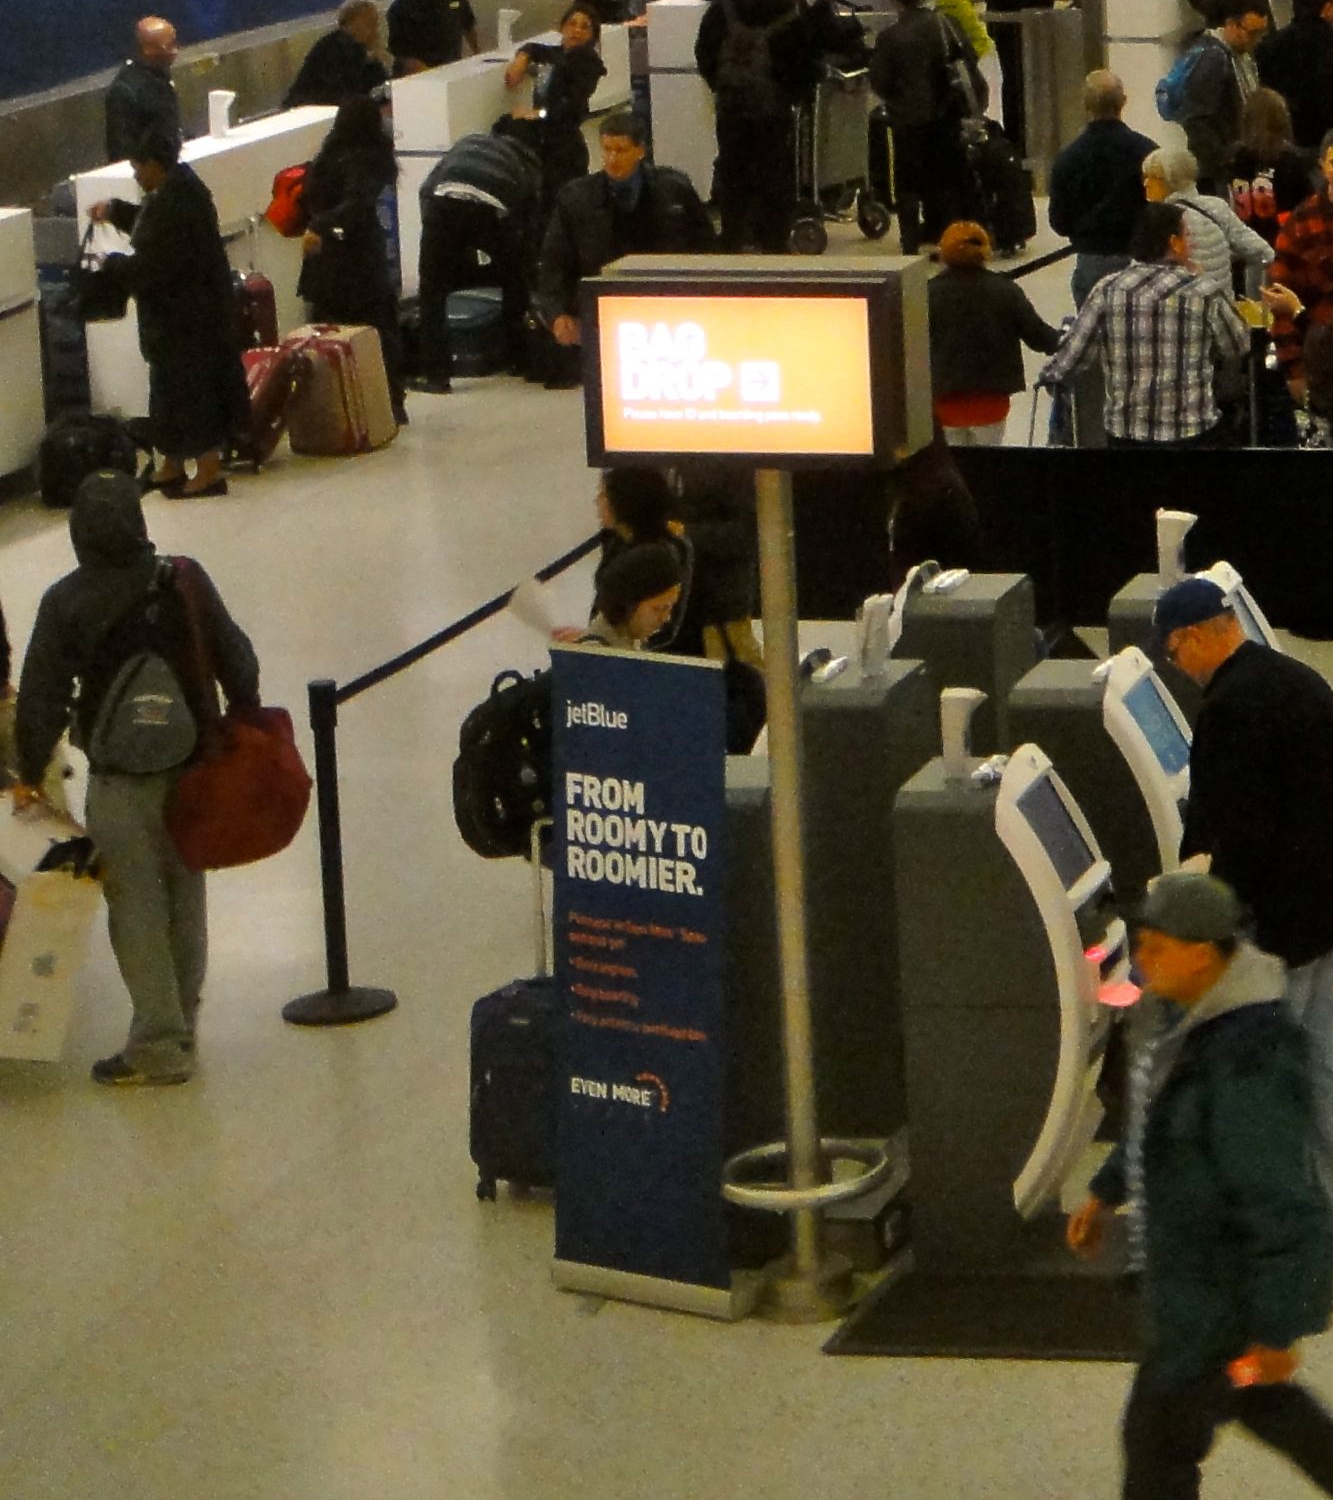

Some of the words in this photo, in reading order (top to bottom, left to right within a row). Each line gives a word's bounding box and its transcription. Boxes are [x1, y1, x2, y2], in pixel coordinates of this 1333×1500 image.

[619, 322, 705, 360] BAG
[622, 361, 732, 401] DROP
[566, 700, 628, 729] jetBlue
[565, 772, 645, 815] FROM
[567, 808, 667, 853] ROOMY
[671, 823, 708, 860] TO
[567, 846, 704, 896] ROOMIER.
[570, 1077, 607, 1099] EVEN
[612, 1083, 653, 1107] MORE
